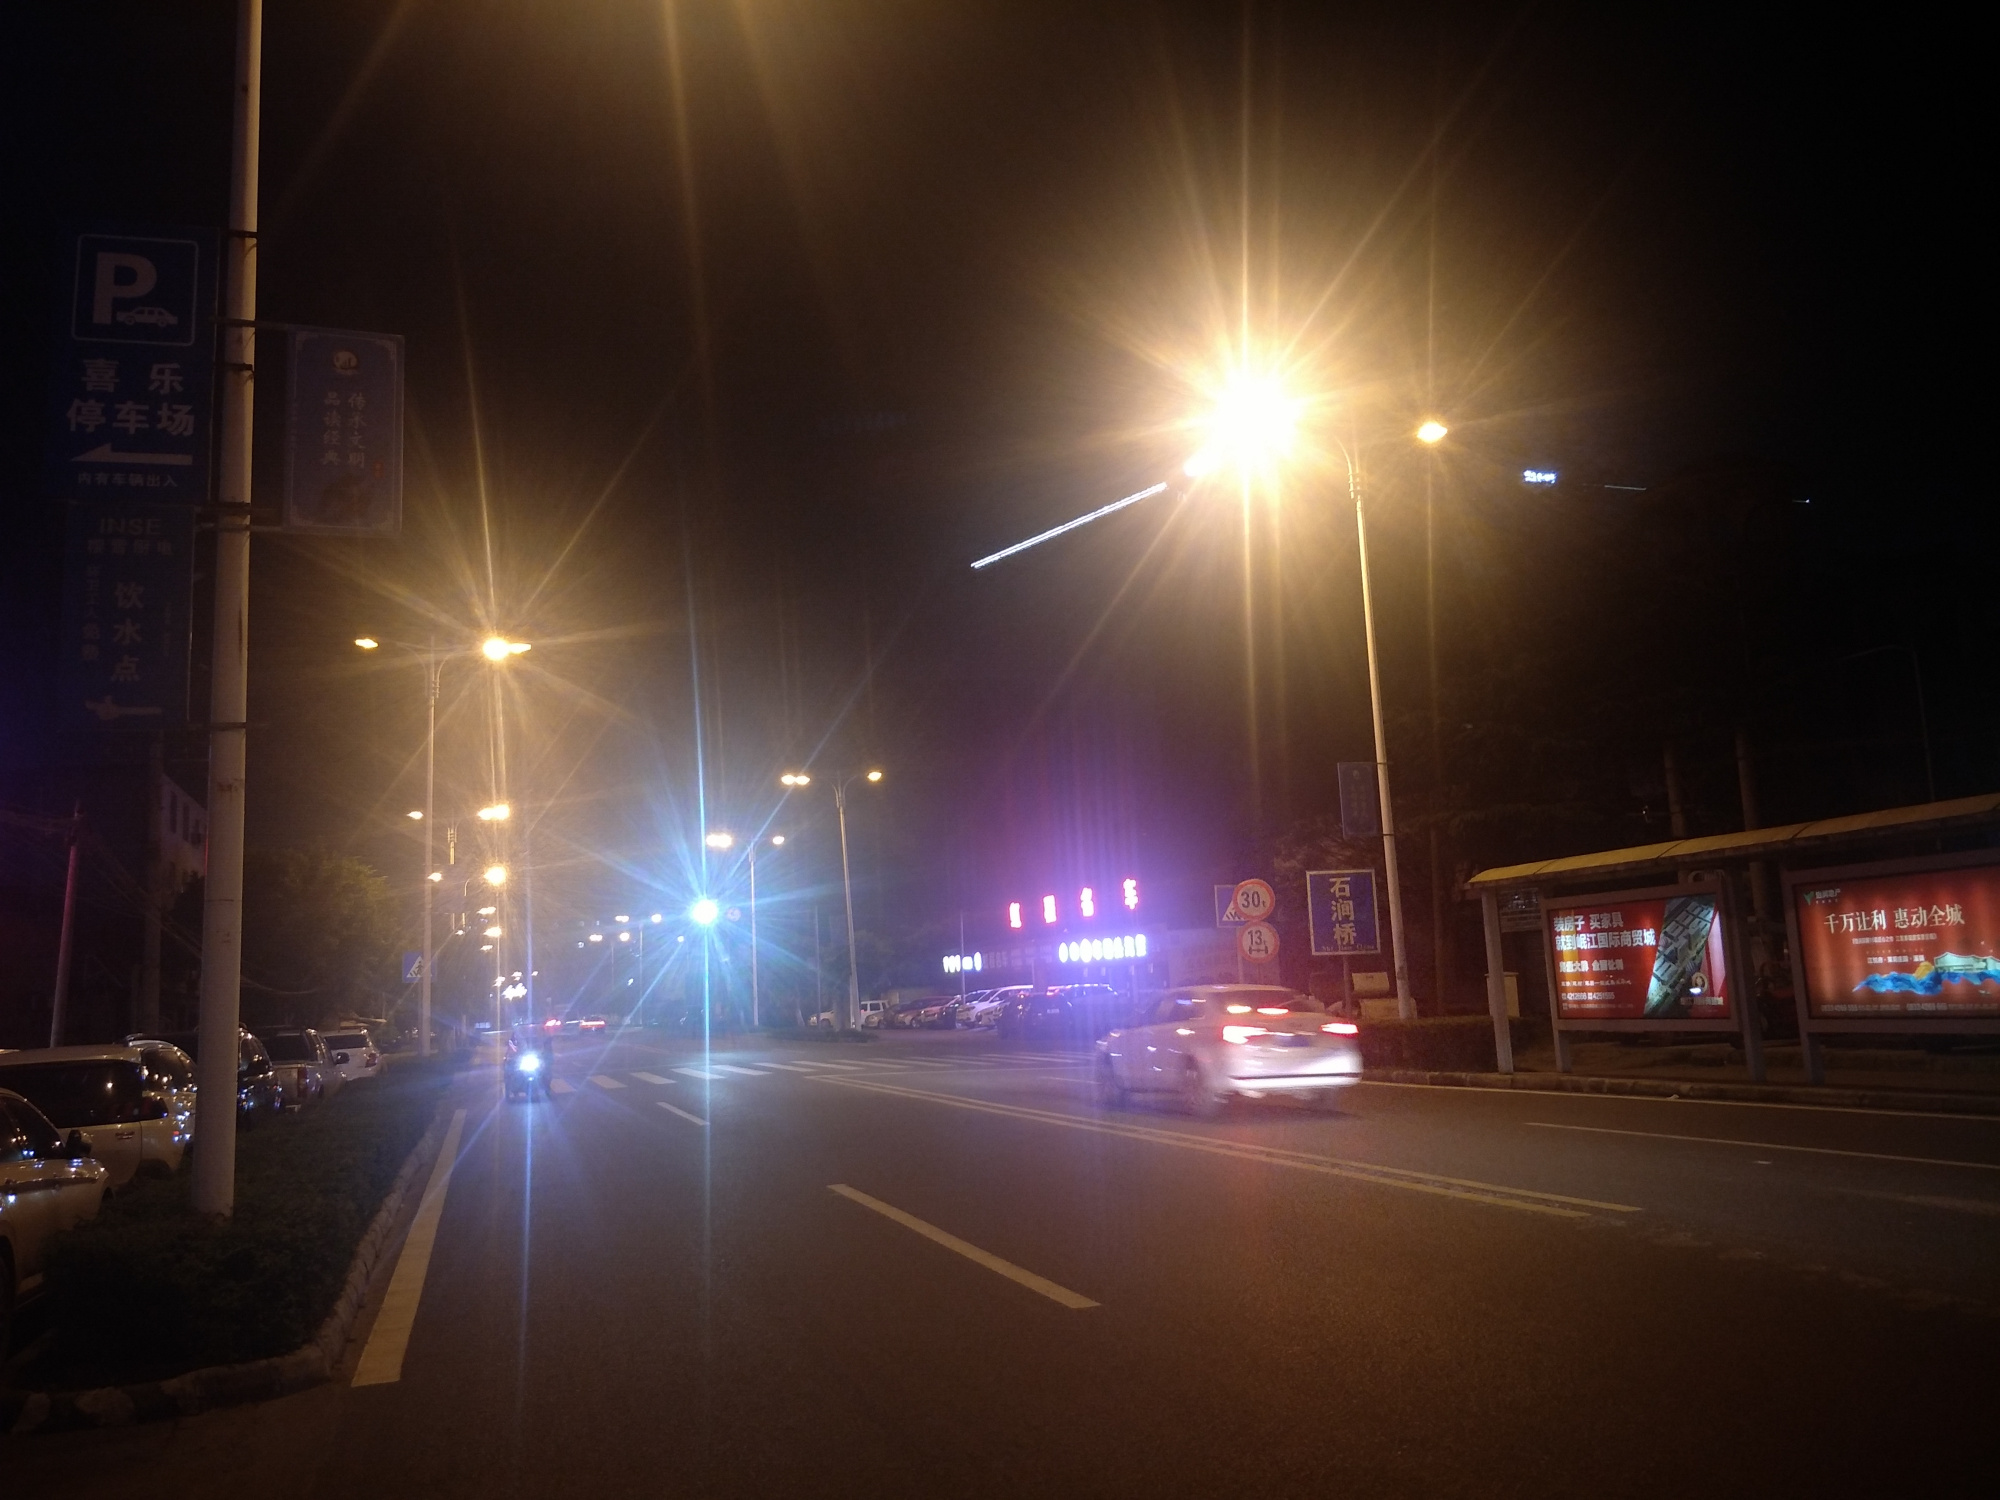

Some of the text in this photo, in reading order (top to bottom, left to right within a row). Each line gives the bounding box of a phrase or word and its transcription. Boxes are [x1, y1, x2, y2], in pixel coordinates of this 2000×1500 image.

[92, 252, 157, 324] P
[81, 359, 184, 395] 喜乐
[66, 399, 195, 436] 停车场
[77, 472, 178, 488] 内有车辆出入
[110, 581, 146, 682] 饮水点
[1329, 876, 1357, 946] 石涧桥
[1554, 912, 1624, 932] 装房子 买家具
[1823, 903, 1965, 934] 千万让利 惠动全城
[1555, 928, 1657, 950] 就到岷江国际商贸城
